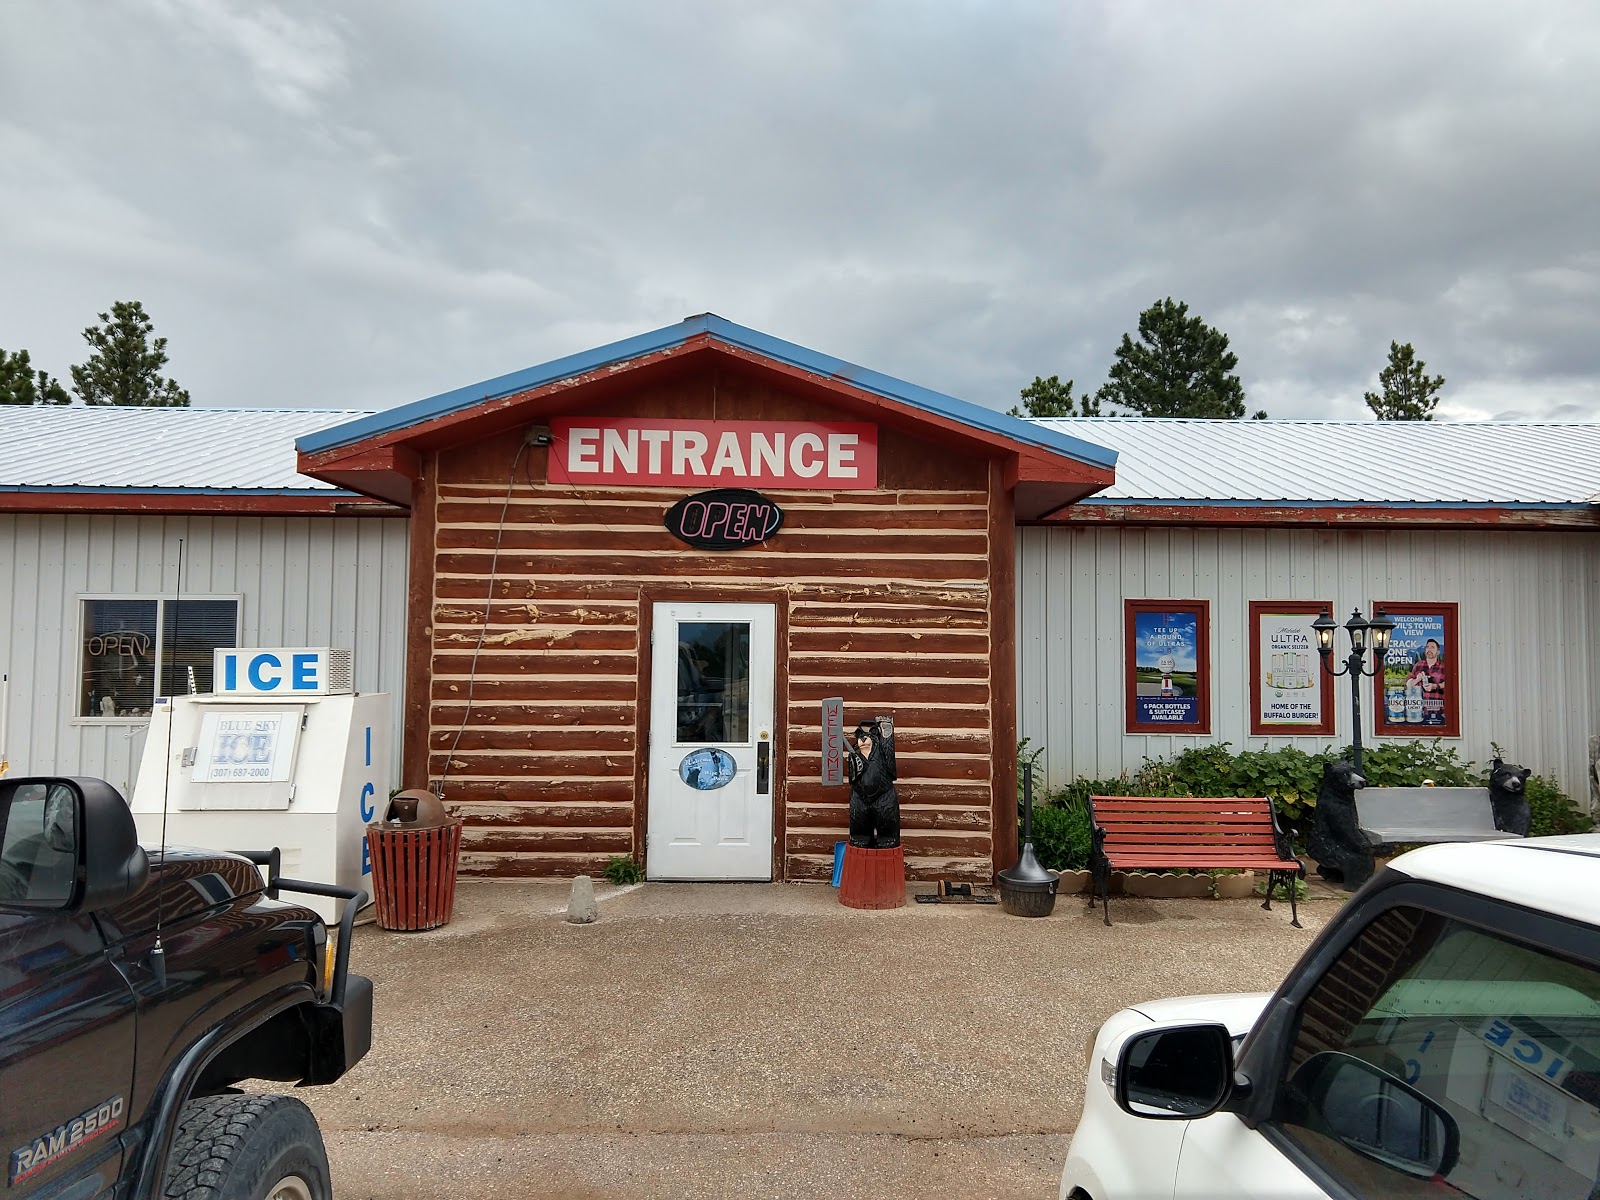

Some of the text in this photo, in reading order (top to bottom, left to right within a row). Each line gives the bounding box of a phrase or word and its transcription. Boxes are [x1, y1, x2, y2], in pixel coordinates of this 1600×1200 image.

[568, 428, 859, 479] ENTRANCE
[680, 501, 771, 541] OPEN
[88, 636, 147, 656] OPEN
[1271, 634, 1309, 643] ULTRA
[1388, 640, 1417, 648] CRACK
[1387, 648, 1407, 656] ONE
[1387, 656, 1413, 665] OPEN
[225, 653, 319, 691] ICE
[220, 720, 279, 731] BLUE SKY
[212, 733, 273, 765] ICE
[826, 704, 839, 782] WELCOME
[211, 767, 270, 779] (307) 687-2000
[17, 1097, 123, 1174] RAM 2500
